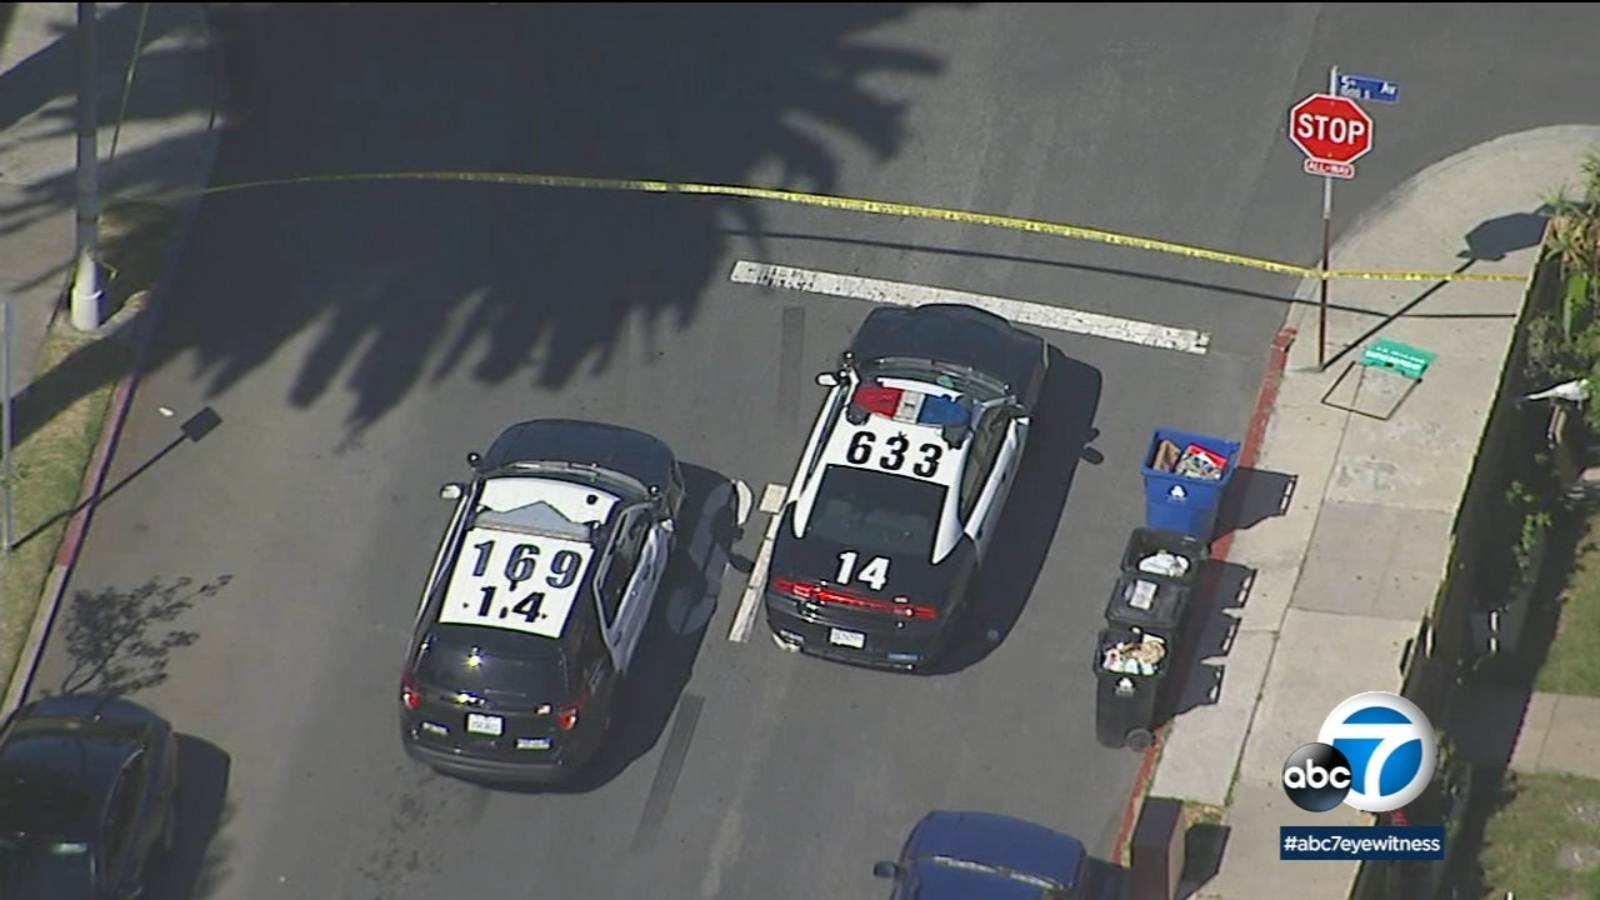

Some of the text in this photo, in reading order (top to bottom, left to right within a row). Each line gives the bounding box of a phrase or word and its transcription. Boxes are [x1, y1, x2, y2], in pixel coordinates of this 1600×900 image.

[1297, 113, 1365, 145] STOP
[846, 431, 943, 478] 633
[472, 540, 583, 589] 169
[837, 552, 891, 591] 14
